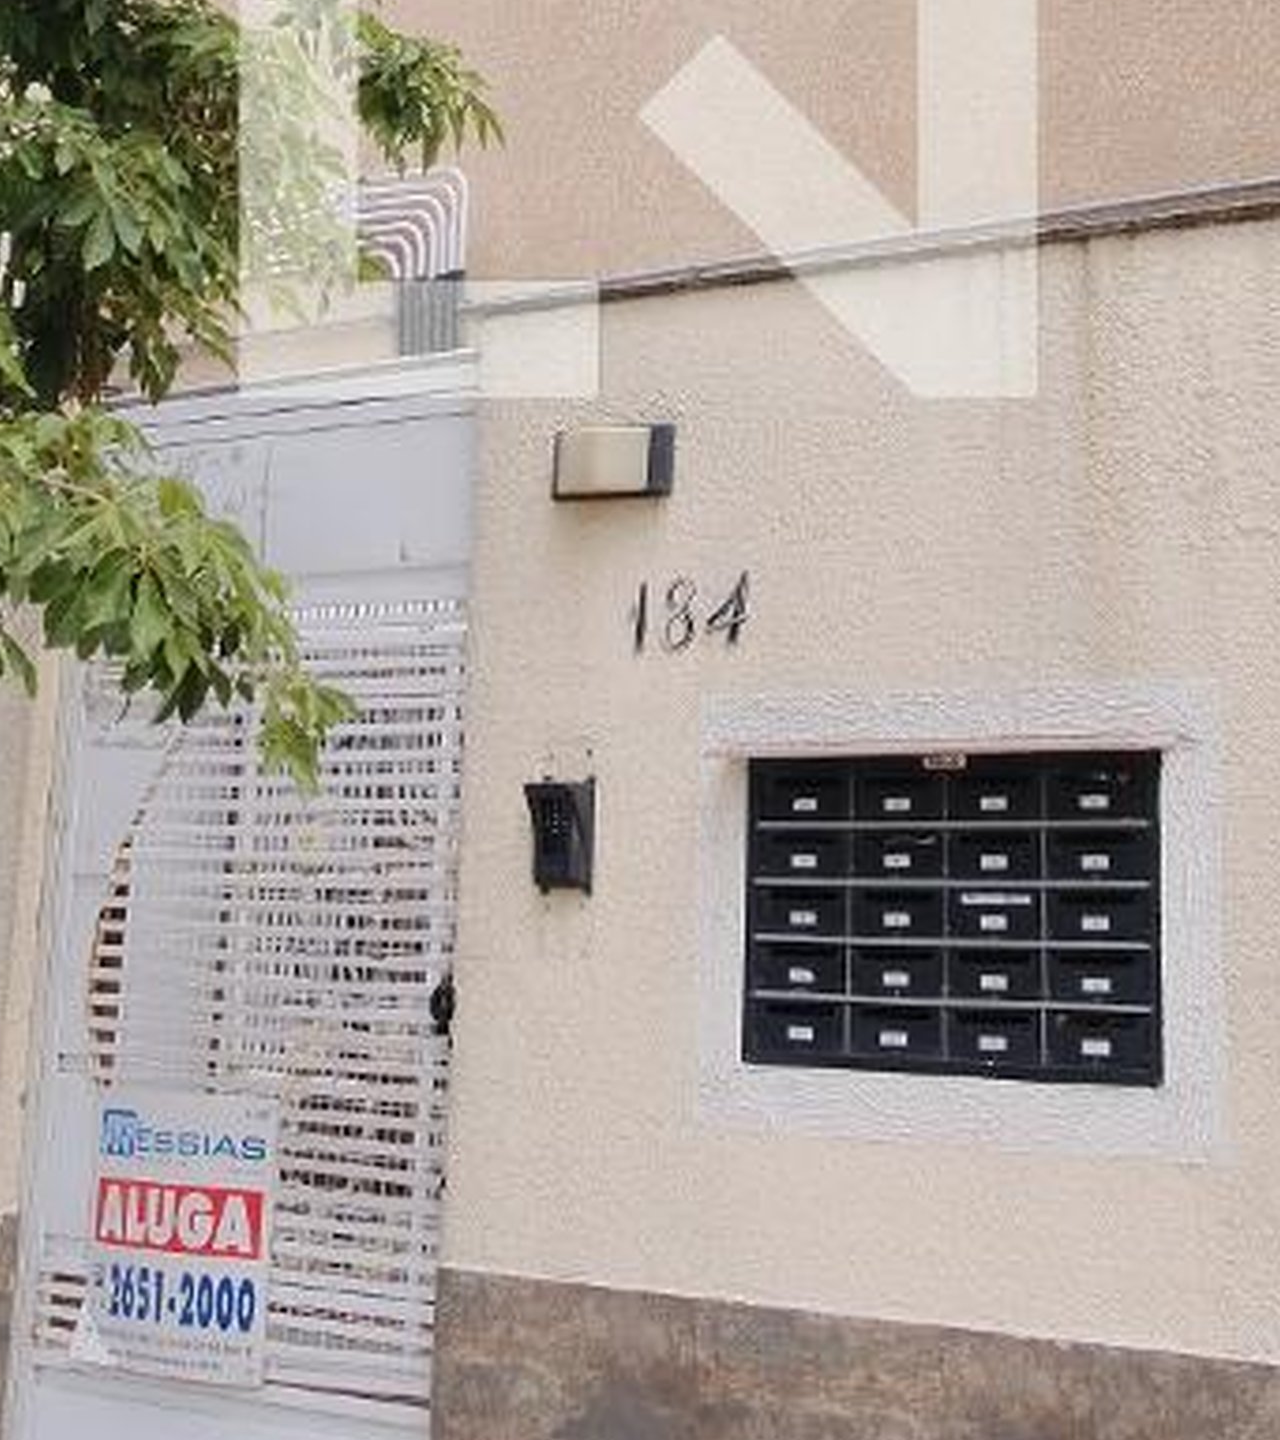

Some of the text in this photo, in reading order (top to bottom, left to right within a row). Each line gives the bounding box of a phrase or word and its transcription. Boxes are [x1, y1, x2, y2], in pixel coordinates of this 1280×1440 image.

[629, 570, 749, 654] 184
[99, 1183, 254, 1253] ALUGA
[108, 1264, 255, 1333] 2651-2000
